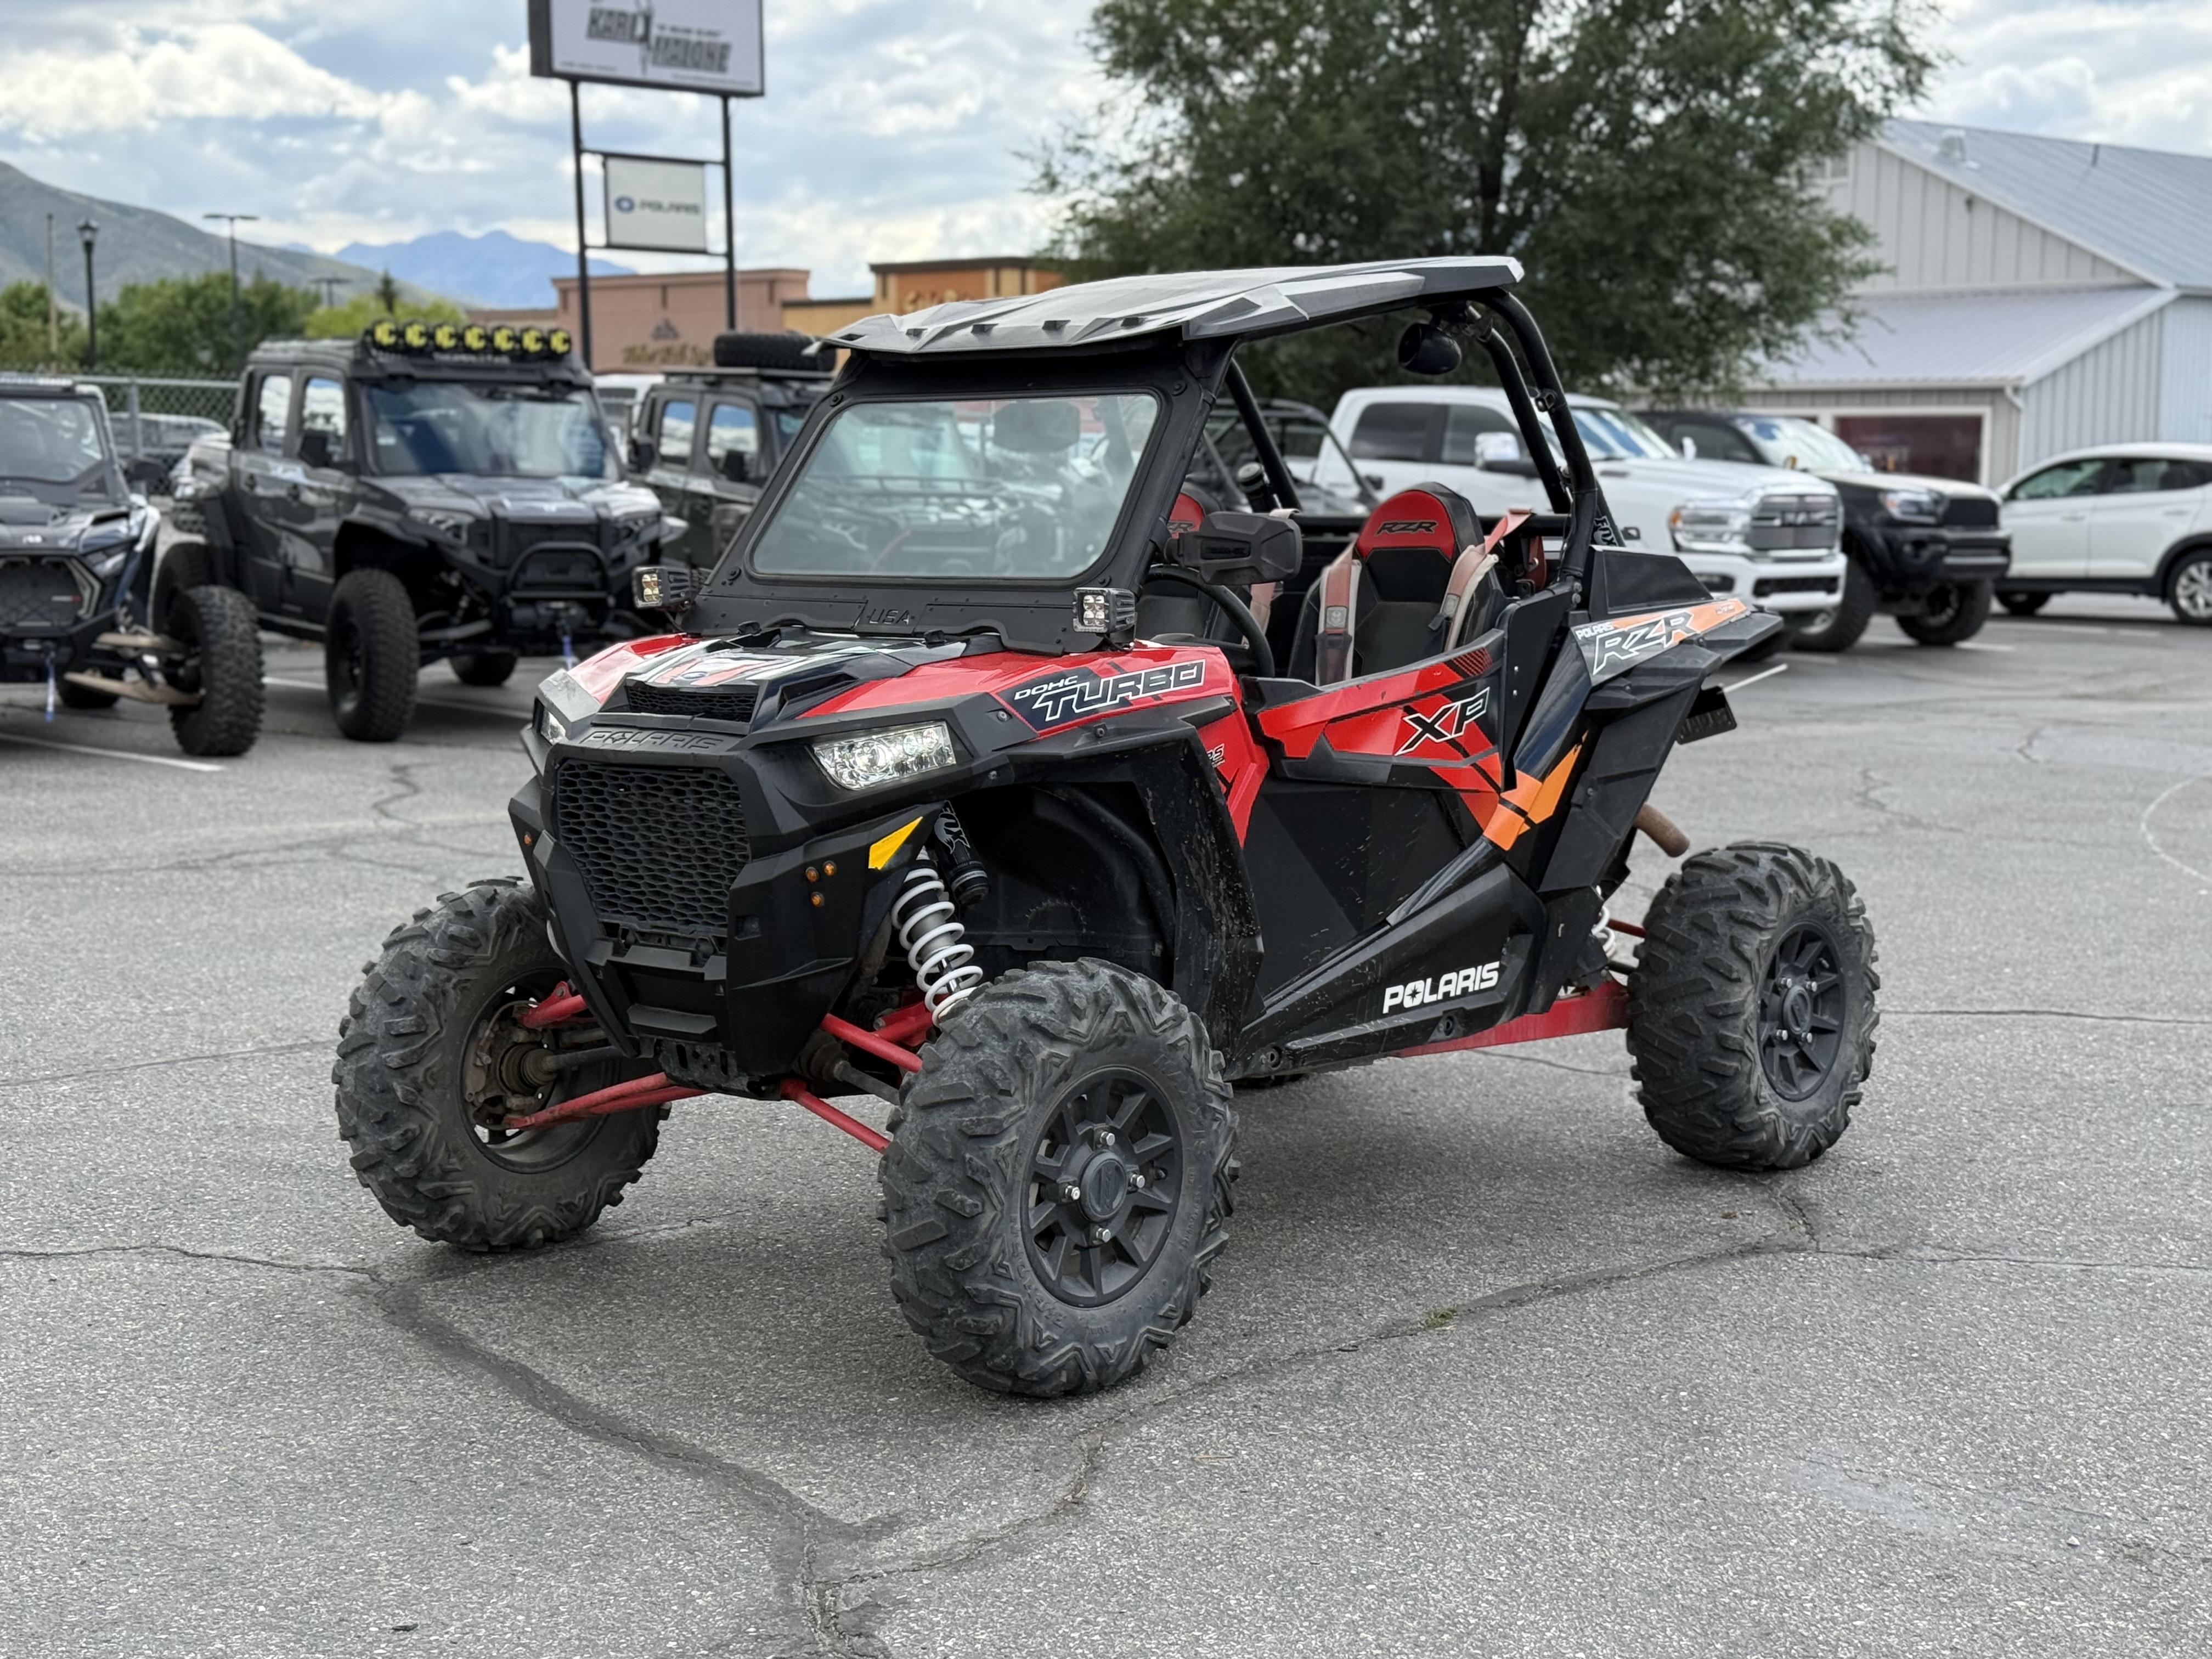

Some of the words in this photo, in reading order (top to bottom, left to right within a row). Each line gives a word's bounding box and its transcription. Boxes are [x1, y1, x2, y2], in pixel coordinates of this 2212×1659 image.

[1374, 520, 1438, 536] RZR
[869, 608, 910, 625] USA
[1575, 621, 1615, 640] POLARIS
[1592, 610, 1701, 676] RZR
[1014, 675, 1079, 701] DOHC
[1031, 659, 1206, 722] TURBO
[1394, 686, 1491, 756] XP
[579, 730, 724, 749] POLARIS
[1383, 961, 1500, 1014] POLARIS
